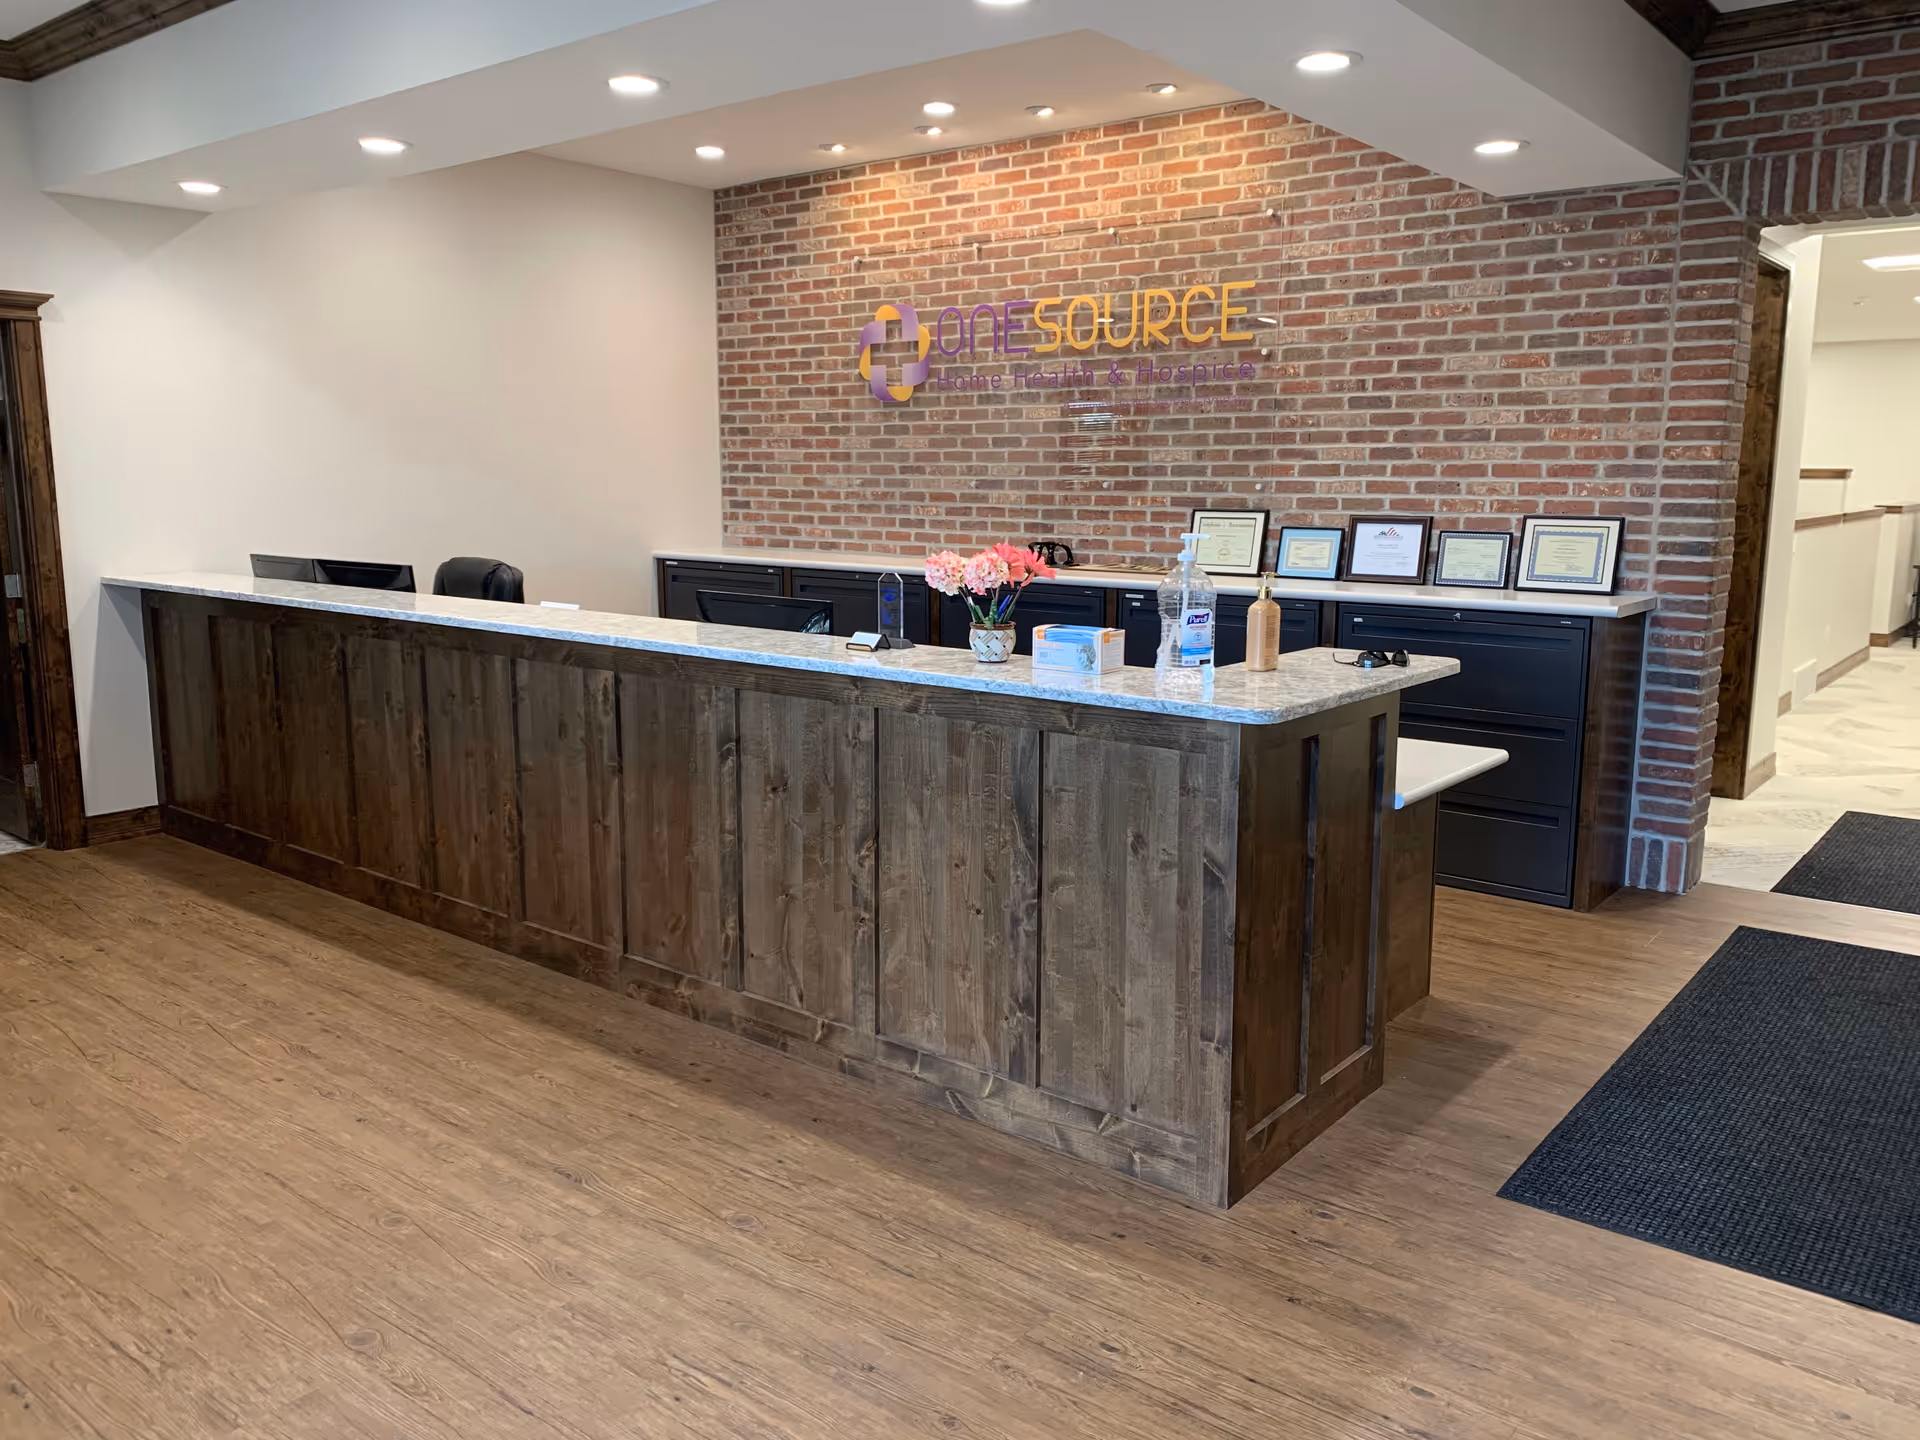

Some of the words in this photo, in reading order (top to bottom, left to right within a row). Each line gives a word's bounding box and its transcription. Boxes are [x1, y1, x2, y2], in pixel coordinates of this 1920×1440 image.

[937, 368, 1001, 391] Home
[1014, 360, 1094, 388] Health
[1107, 361, 1124, 384] &
[1137, 357, 1254, 387] Hospice
